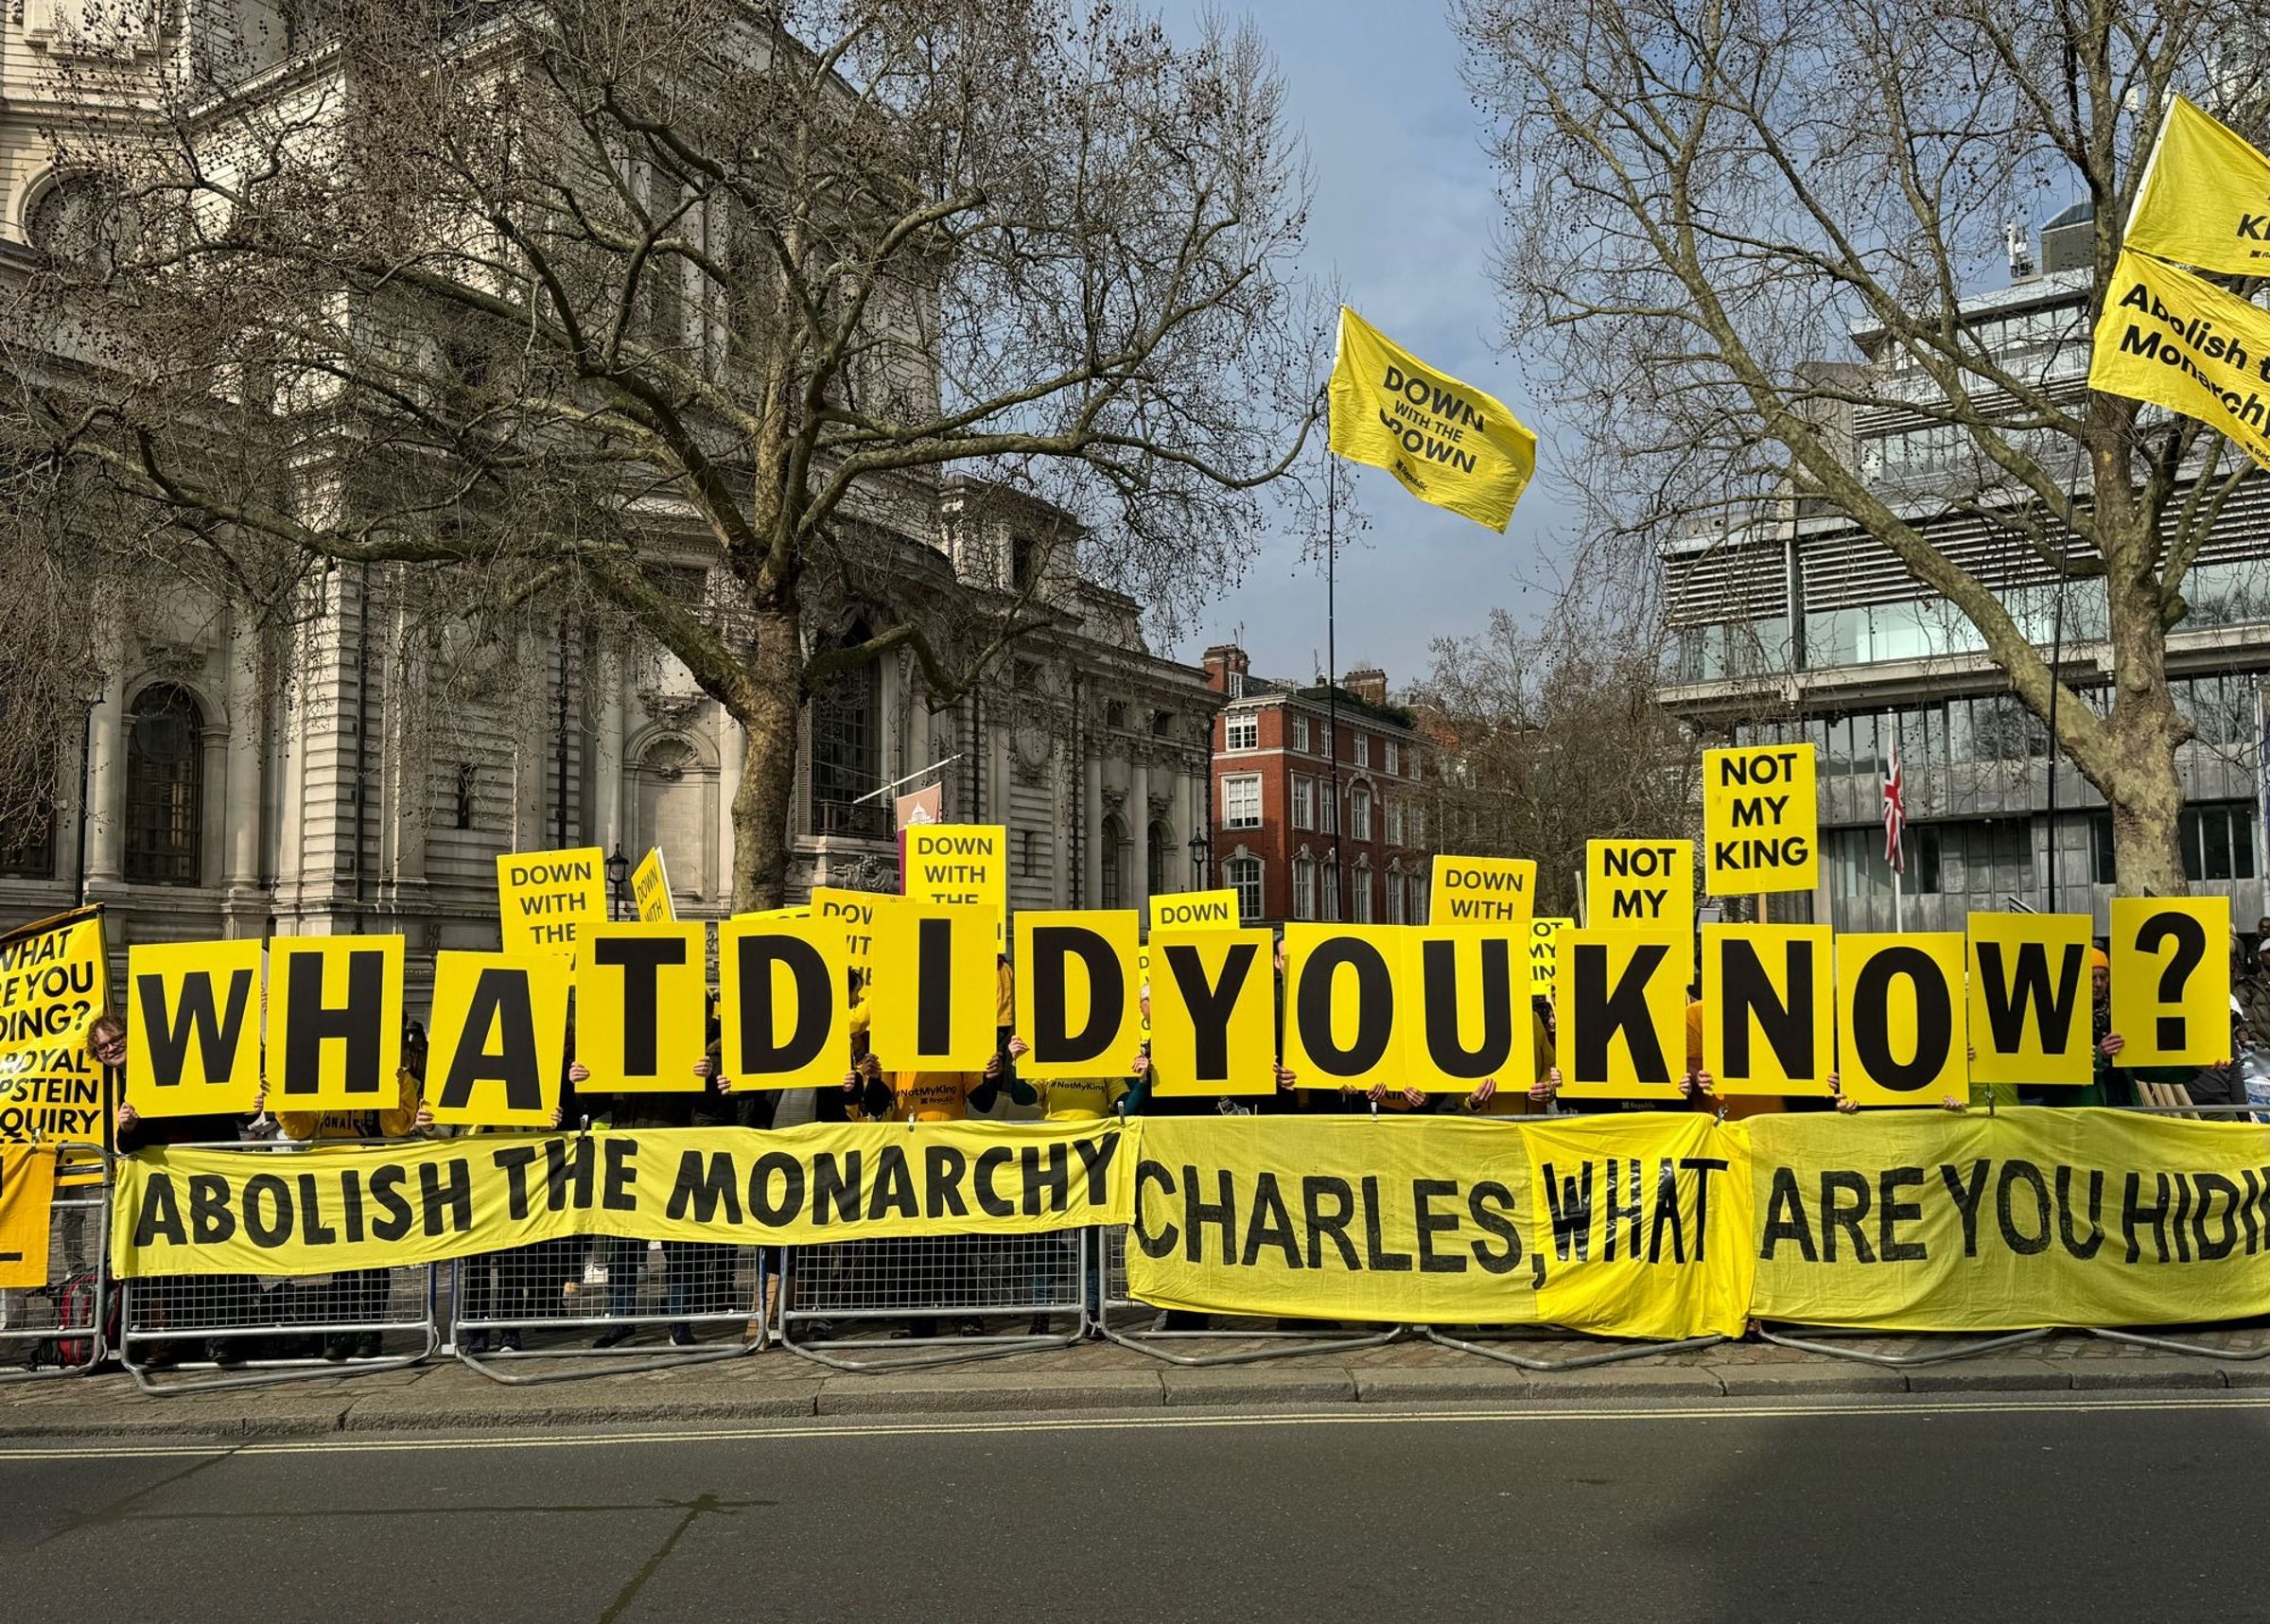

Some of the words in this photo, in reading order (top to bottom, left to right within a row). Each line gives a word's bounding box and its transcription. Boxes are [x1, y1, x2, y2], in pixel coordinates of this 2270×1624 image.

[2119, 283, 2248, 370] Abolish
[1383, 365, 1484, 433] DOWN
[1394, 399, 1430, 429] WITH
[1435, 421, 1464, 444] THE
[1721, 753, 1798, 787] NOT
[1732, 795, 1790, 828] MY
[917, 837, 993, 855] DOWN
[1715, 837, 1808, 870] KING
[511, 862, 591, 886] DOWN
[924, 865, 986, 883] WITH
[1604, 847, 1677, 877] NOT
[637, 864, 659, 904] DOWN
[1445, 869, 1523, 892] DOWN
[520, 892, 586, 916] WITH
[1161, 902, 1229, 924] DOWN
[1451, 899, 1513, 920] WITH
[1613, 889, 1668, 918] MY
[530, 923, 576, 944] THE
[26, 961, 94, 998] YOU
[133, 1162, 472, 1248] ABOLISH
[493, 1138, 638, 1221] THE
[666, 1132, 1121, 1228] MONARCHY
[1134, 1159, 1545, 1291] CHARLES,
[1542, 1158, 1729, 1264] WHAT
[1760, 1166, 1928, 1265] ARE
[1939, 1159, 2105, 1260] YOU
[2122, 1166, 2270, 1264] HIDI
